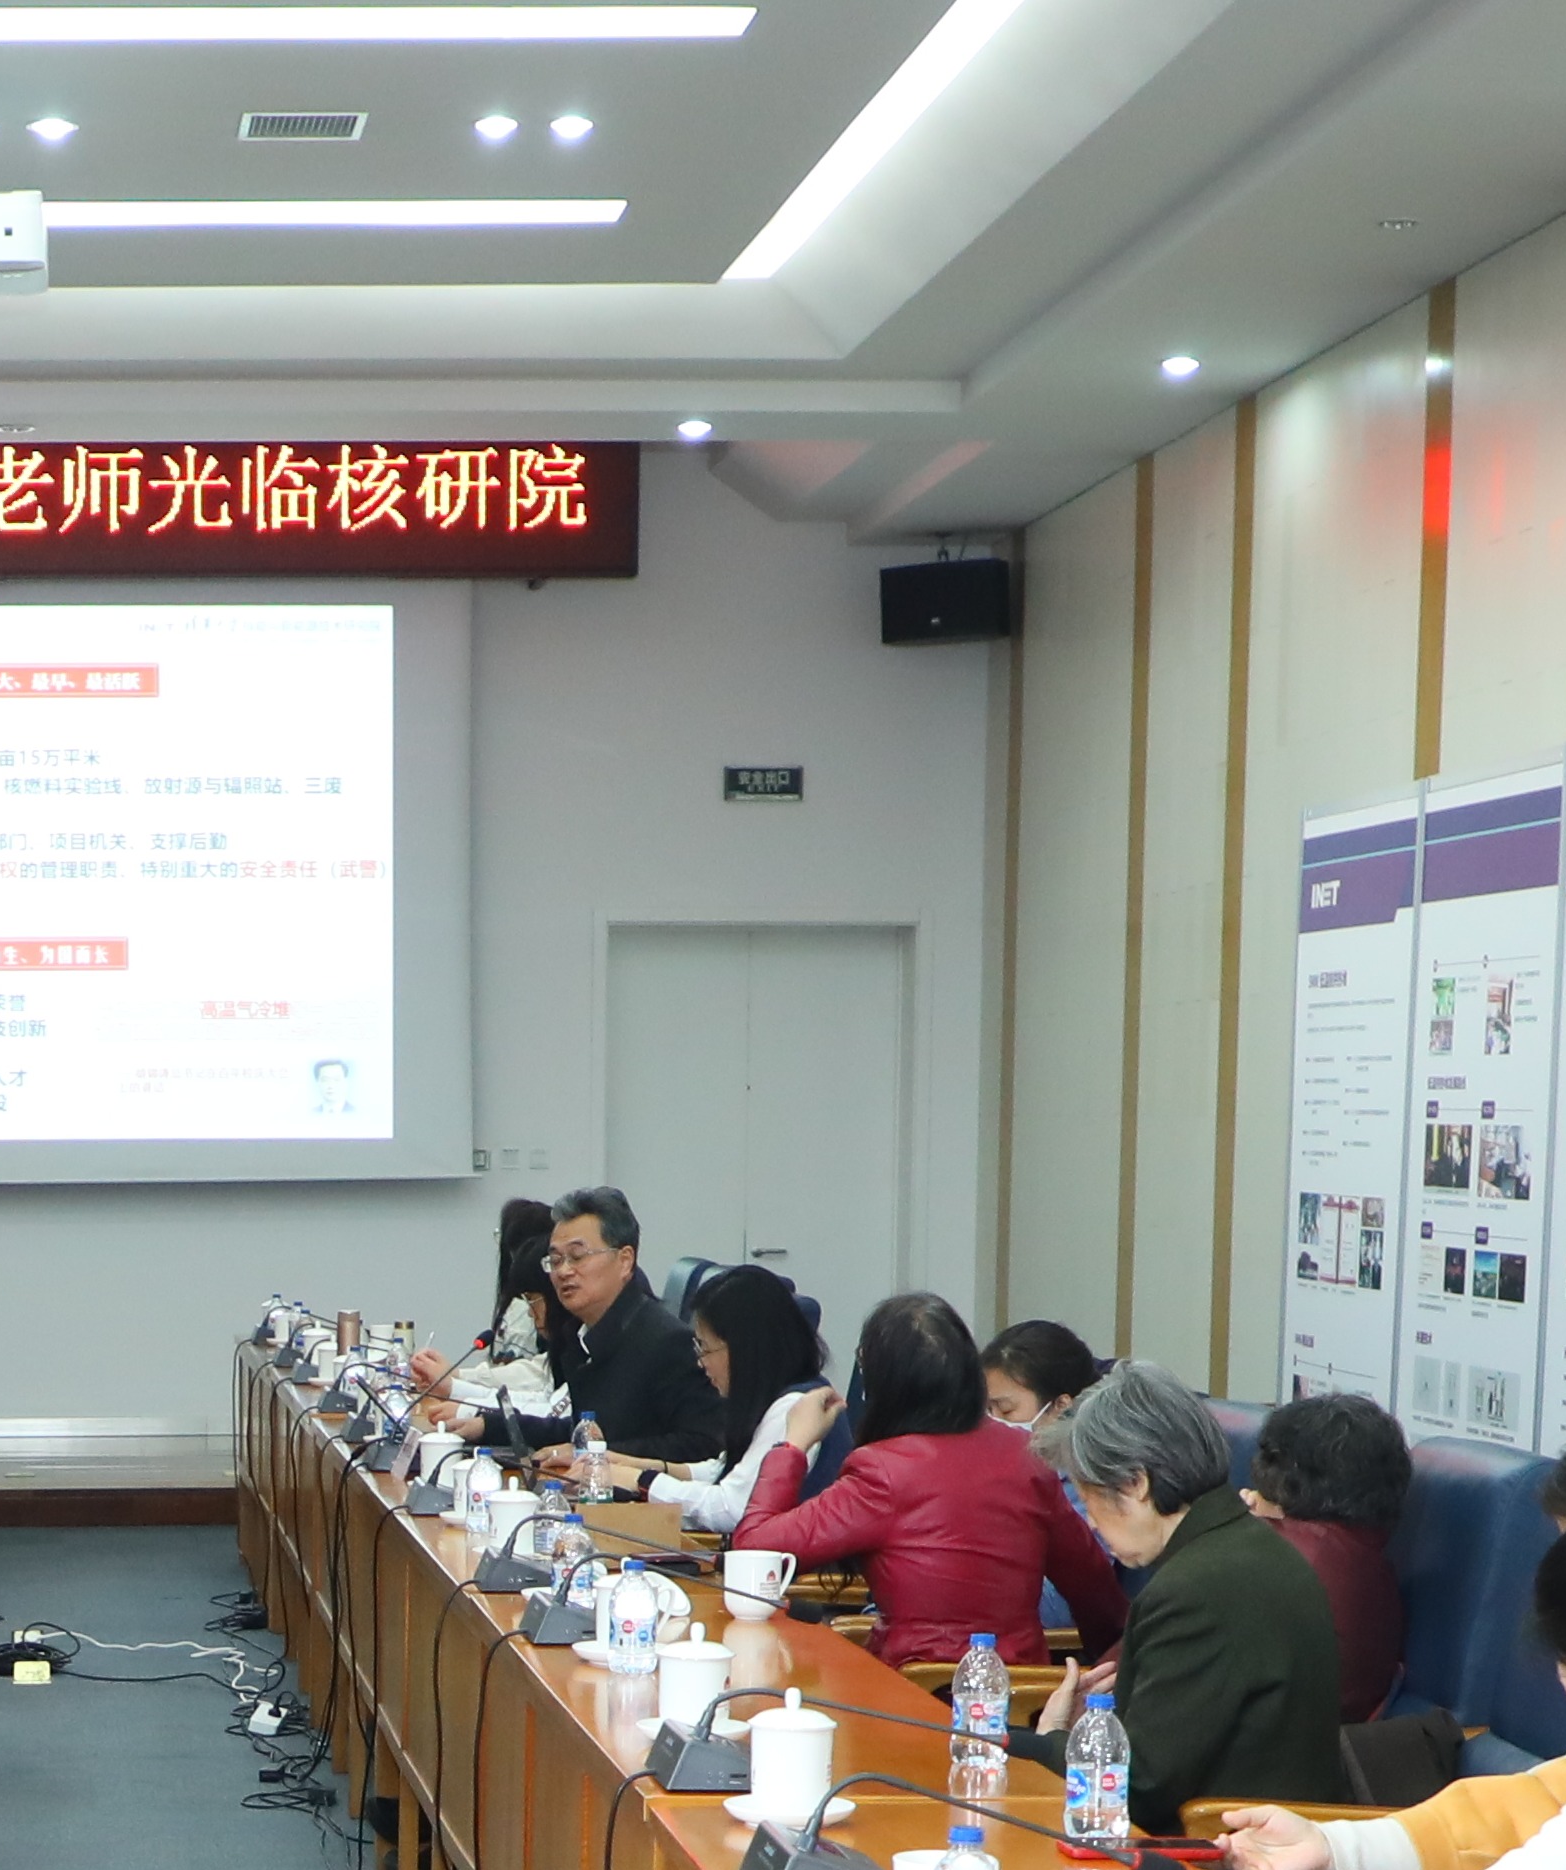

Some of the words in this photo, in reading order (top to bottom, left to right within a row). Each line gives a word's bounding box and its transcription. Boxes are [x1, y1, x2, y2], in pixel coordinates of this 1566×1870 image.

[737, 771, 791, 785] 安全出口
[1311, 880, 1341, 909] INET
[199, 998, 291, 1019] 高温气冷堆
